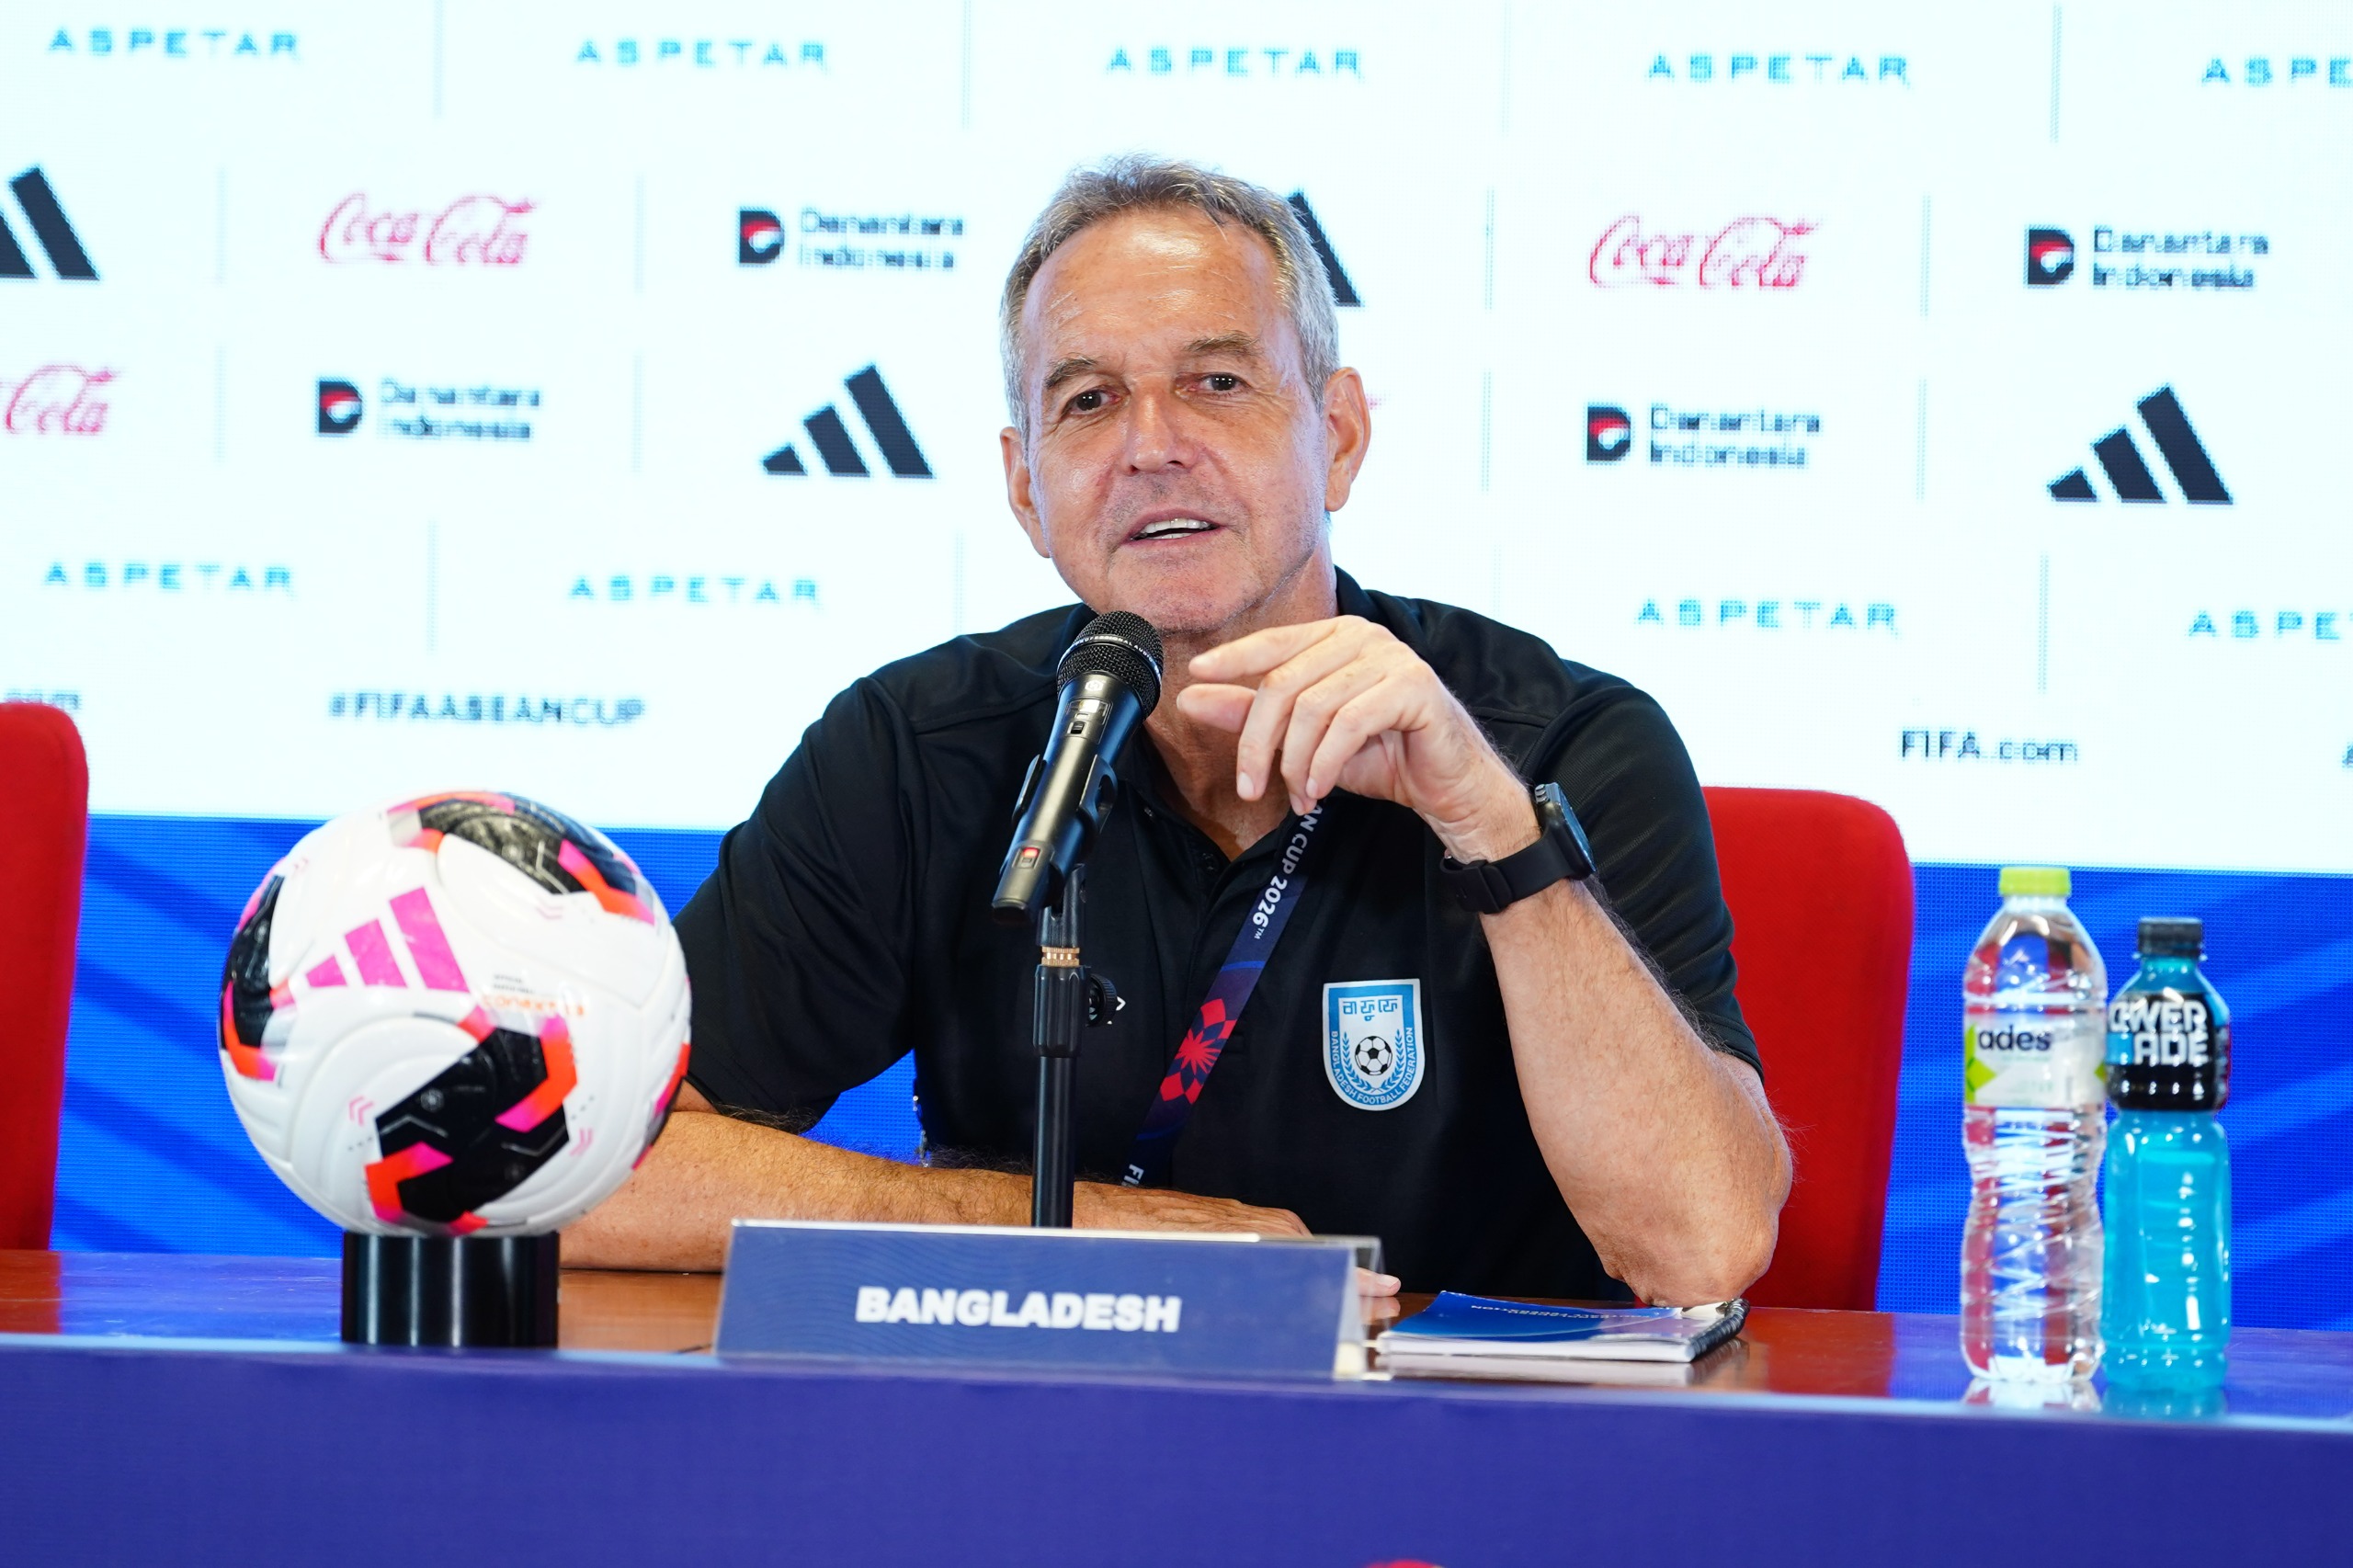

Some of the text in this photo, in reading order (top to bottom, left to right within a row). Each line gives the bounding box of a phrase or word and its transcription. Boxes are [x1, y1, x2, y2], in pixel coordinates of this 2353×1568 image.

[49, 26, 299, 58] ASPETAR
[576, 38, 826, 68] ASPETAR
[1107, 46, 1361, 78] ASPETAR
[1648, 52, 1910, 85] ASPETAR
[44, 561, 292, 591] ASPETAR
[569, 574, 818, 604] ASPETAR
[1636, 598, 1898, 634] ASPETAR
[2188, 609, 2353, 641] ASPE
[1901, 728, 2078, 764] FIFA.com
[1281, 833, 1308, 874] CUP
[2109, 999, 2207, 1032] OWER
[1978, 1025, 2052, 1051] ades
[2133, 1031, 2209, 1066] ADE
[1330, 1027, 1415, 1105] BANGLADESH FOOTBALL FEDERATION
[856, 1286, 1183, 1333] BANGLADESH
